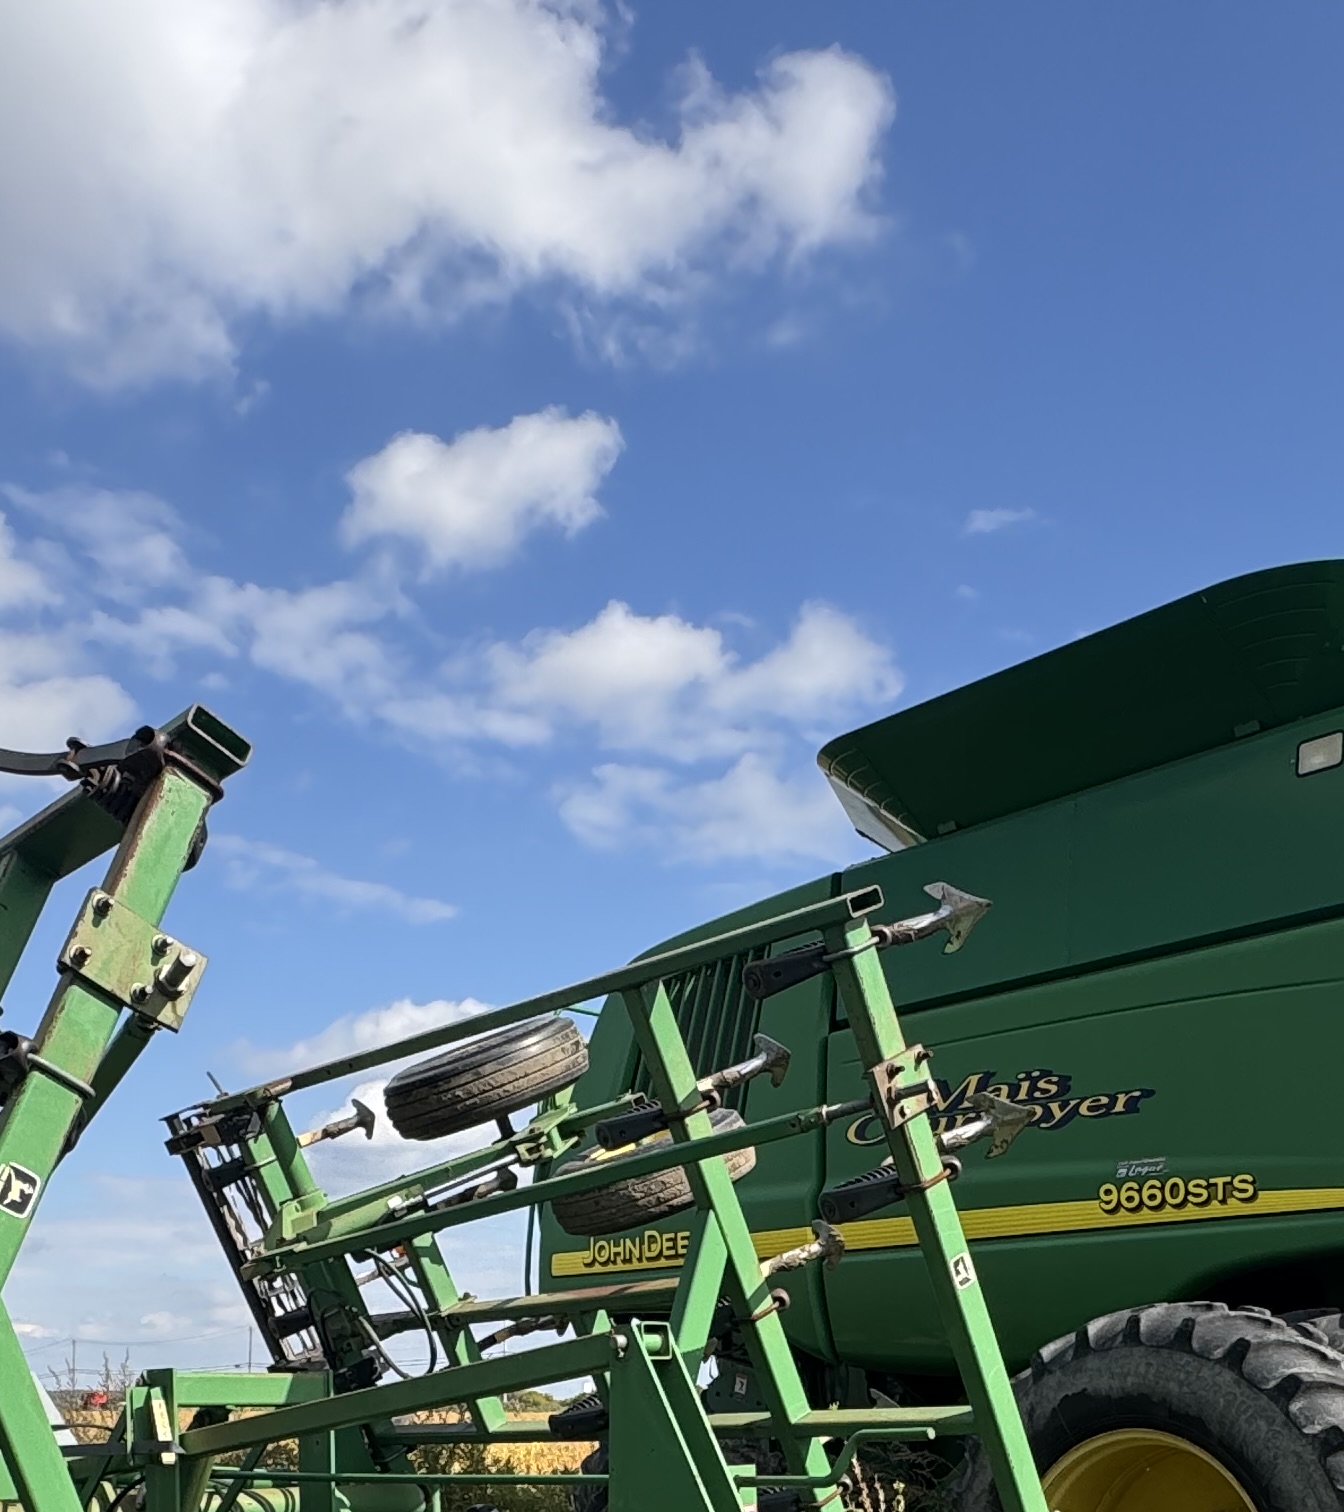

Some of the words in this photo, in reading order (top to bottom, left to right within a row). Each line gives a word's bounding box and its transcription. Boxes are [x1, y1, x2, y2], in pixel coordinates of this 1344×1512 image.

[1098, 1173, 1257, 1211] 9660STS
[582, 1235, 641, 1266] JOHN
[643, 1229, 692, 1258] DEE
